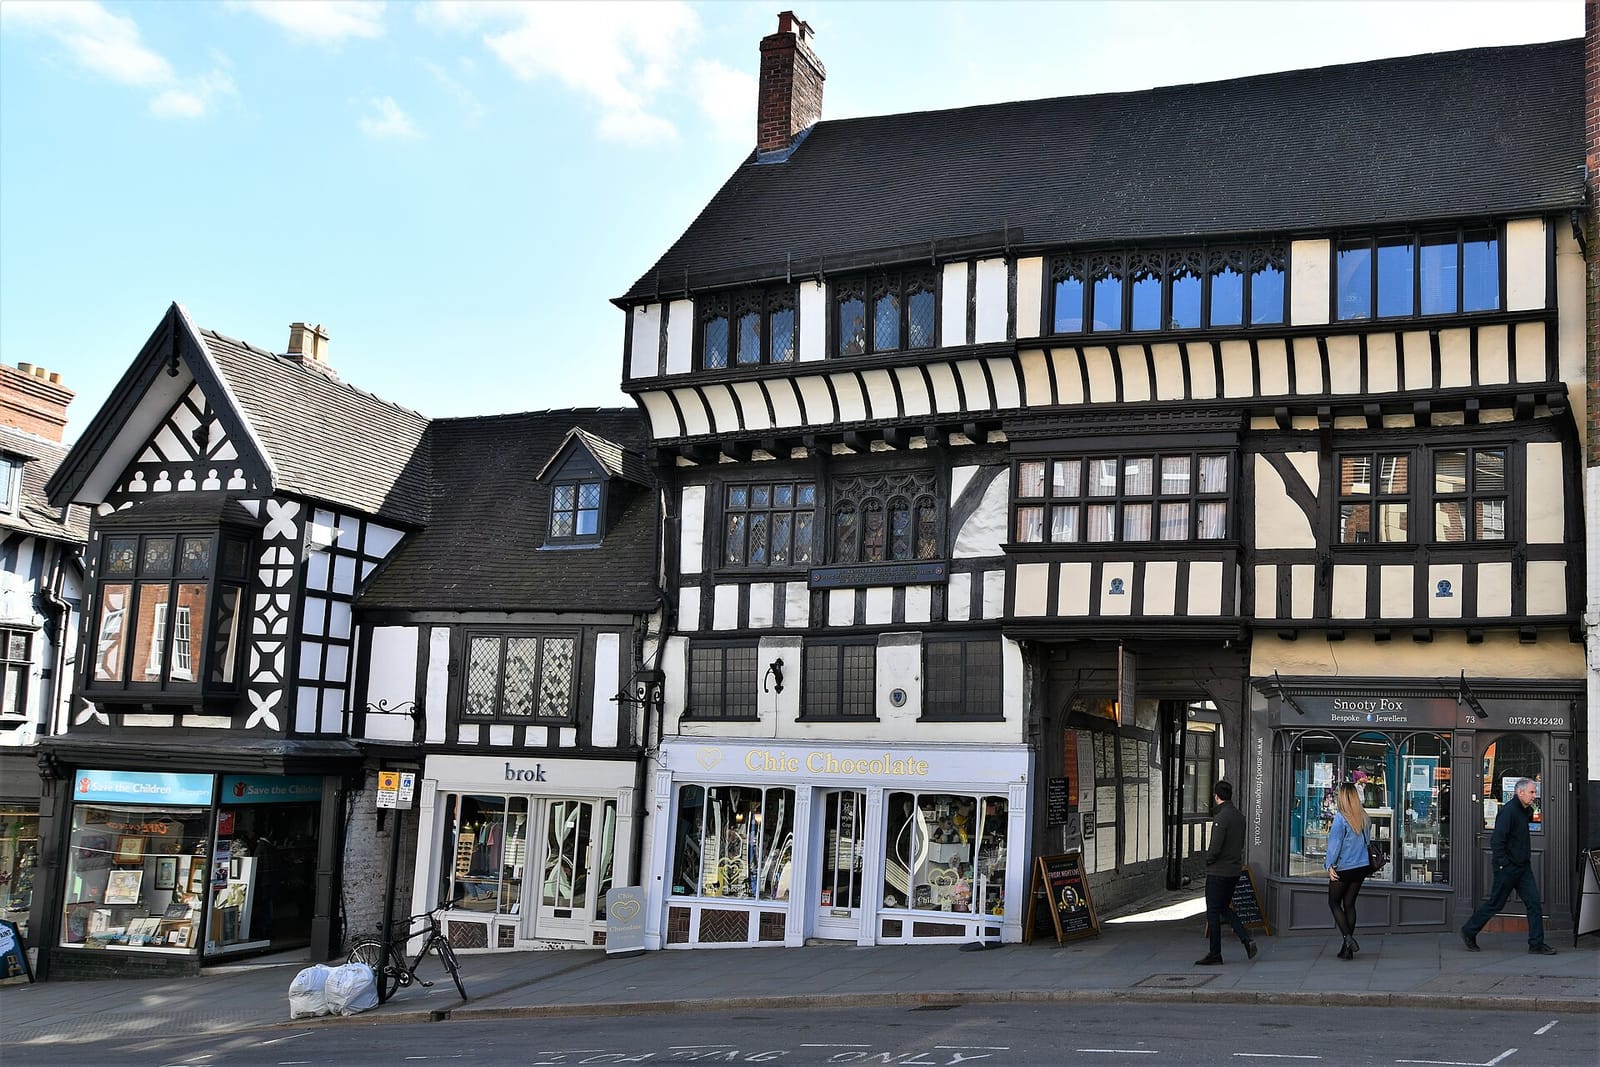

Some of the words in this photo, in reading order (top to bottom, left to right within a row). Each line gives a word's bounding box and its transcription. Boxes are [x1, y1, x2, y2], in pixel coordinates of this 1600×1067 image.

[1333, 698, 1377, 712] Snooty
[1380, 698, 1403, 711] Fox
[1331, 713, 1360, 723] Bespoke
[1375, 714, 1408, 723] Jewellers
[1465, 715, 1476, 724] 73
[1508, 716, 1532, 725] 01743
[1532, 717, 1564, 726] 242420
[744, 749, 799, 773] Chic
[805, 751, 929, 776] Chocolate
[504, 762, 547, 782] brok
[92, 782, 113, 792] Save
[114, 783, 130, 793] the
[132, 783, 172, 794] Children
[247, 785, 270, 795] Save
[271, 784, 287, 794] the
[288, 784, 323, 794] Childre
[1254, 736, 1264, 846] www.snootyfoxjewellery.co.uk
[827, 1051, 993, 1066] ONLY
